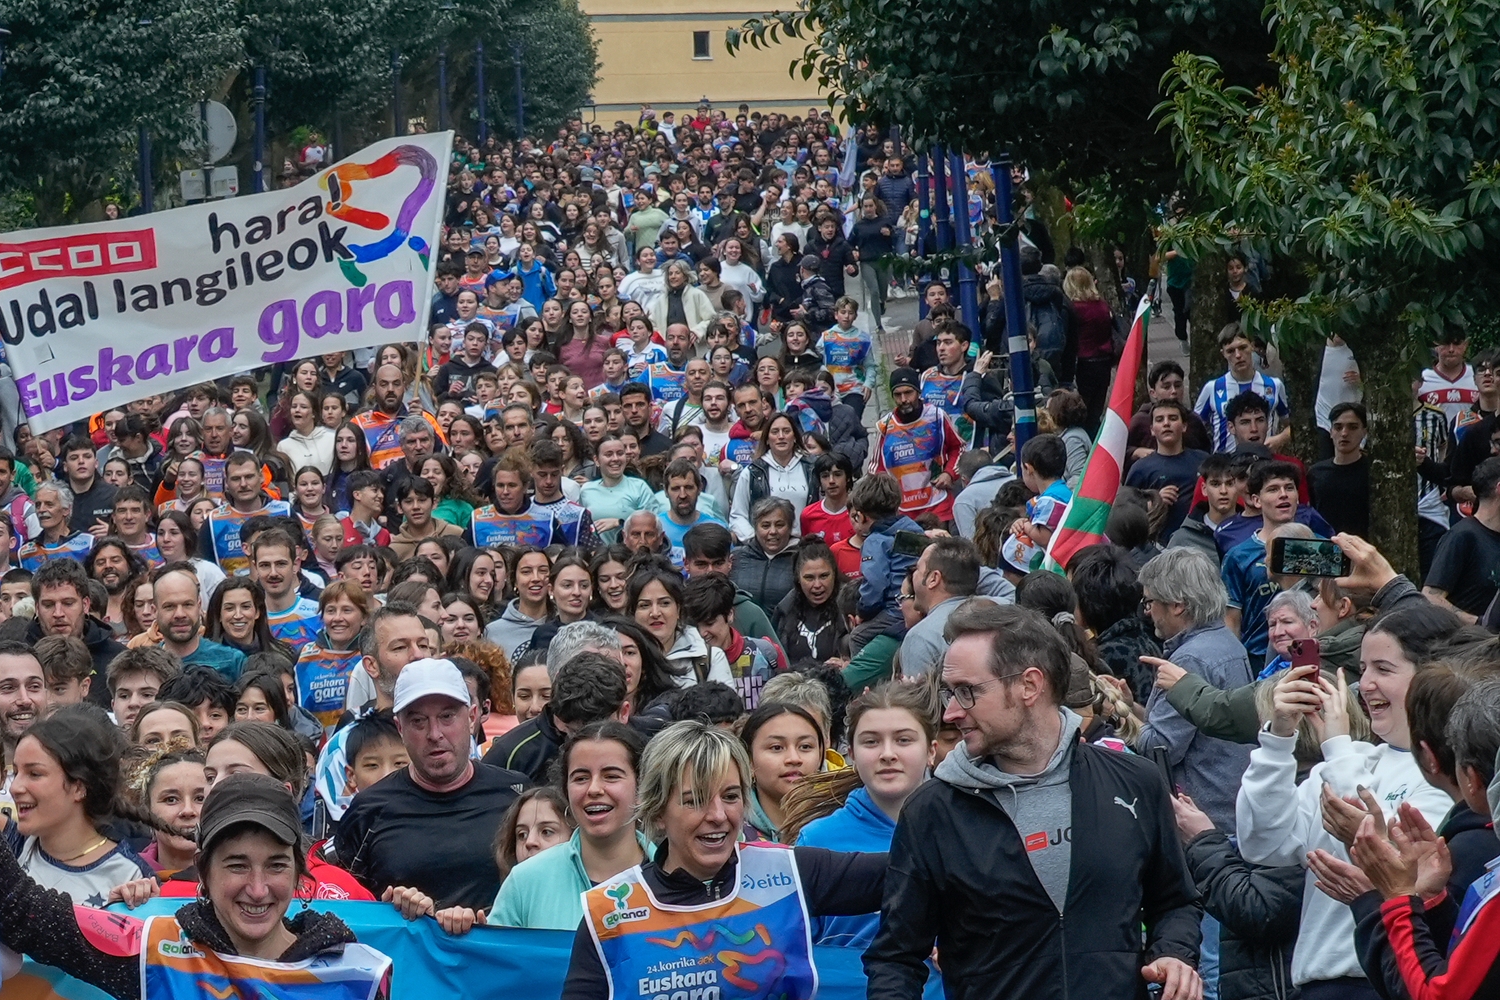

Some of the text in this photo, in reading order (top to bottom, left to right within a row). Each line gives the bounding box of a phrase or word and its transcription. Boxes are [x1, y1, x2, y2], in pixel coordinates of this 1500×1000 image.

[208, 172, 341, 254] hara!
[112, 221, 355, 313] langileok
[15, 279, 416, 419] Euskara gara
[310, 679, 345, 690] Euskara
[314, 685, 346, 703] gara
[757, 872, 792, 889] eitb
[647, 959, 696, 974] 24.korrika
[638, 969, 718, 996] Euskara
